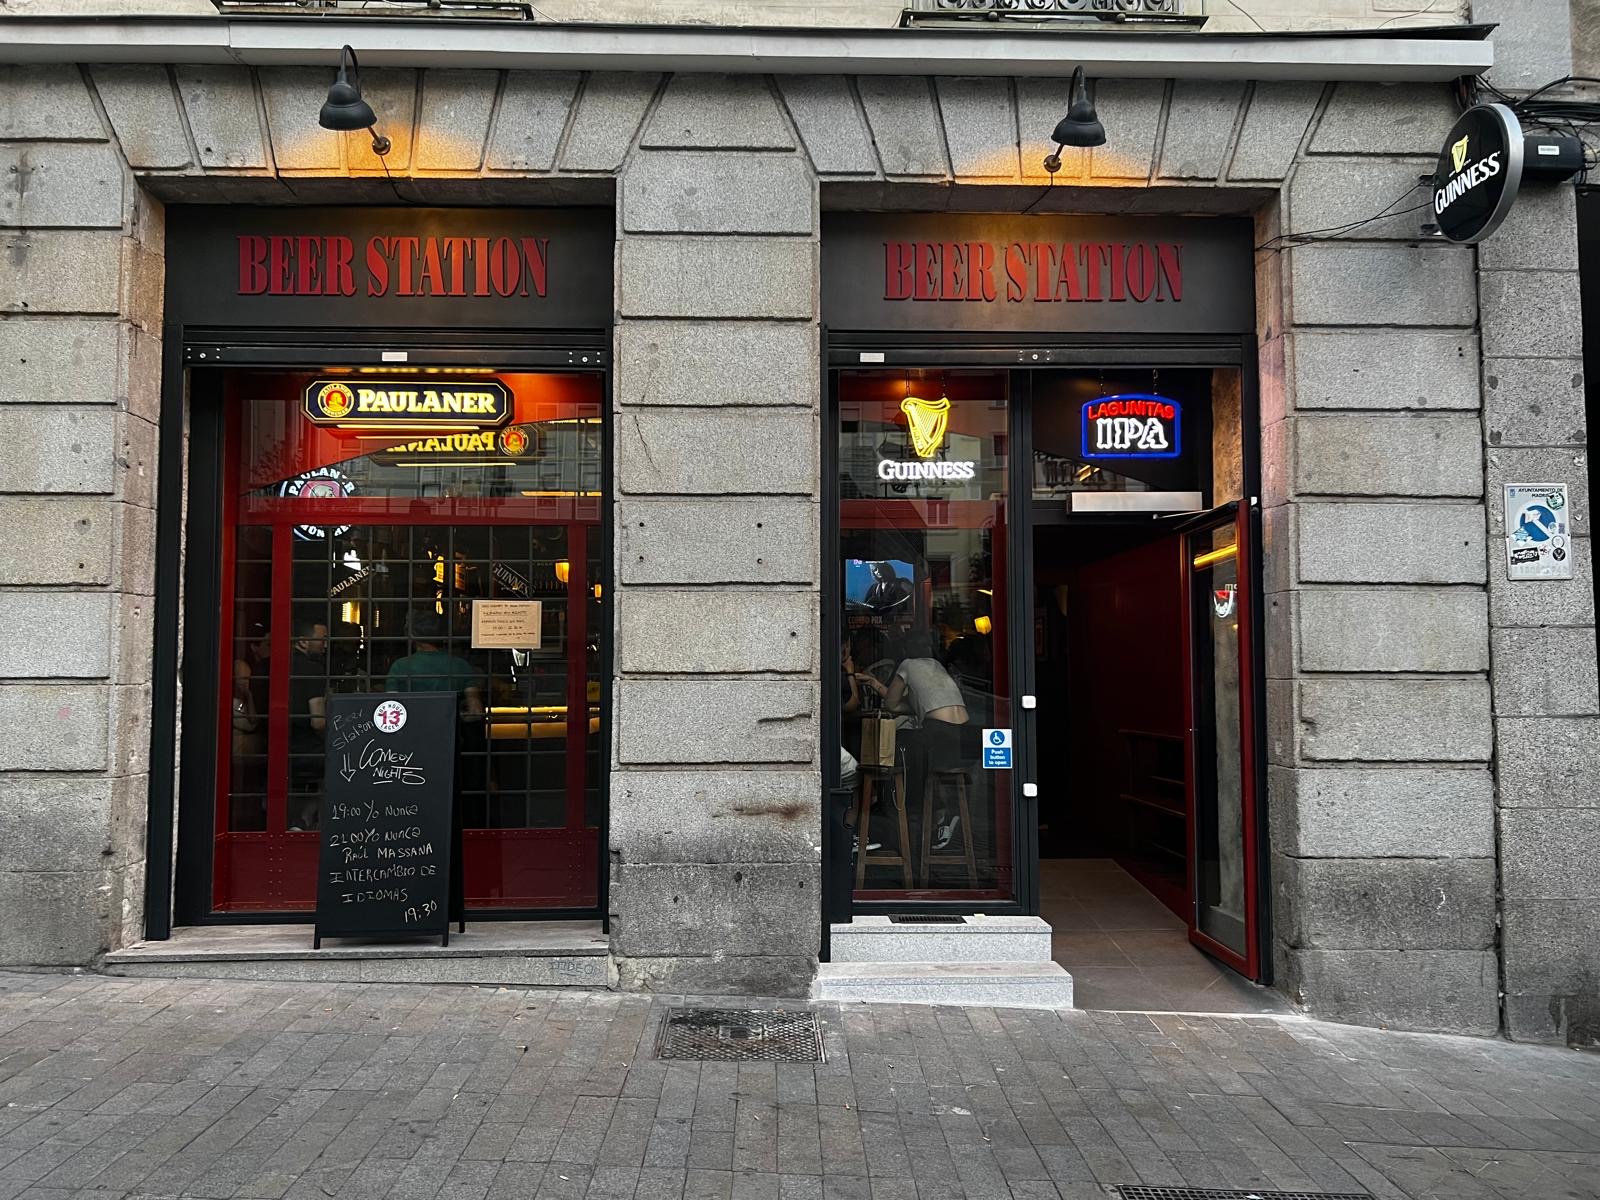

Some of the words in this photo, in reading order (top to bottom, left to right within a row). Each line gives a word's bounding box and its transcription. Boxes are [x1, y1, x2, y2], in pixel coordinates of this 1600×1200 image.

[1434, 150, 1501, 215] GUINNESS
[236, 235, 357, 297] BEER
[366, 236, 550, 298] STATION
[883, 240, 997, 303] BEER
[1004, 243, 1183, 303] STATION
[357, 389, 496, 414] PAULANER
[1088, 400, 1175, 420] LAGUNITAS
[1096, 417, 1169, 450] IPA
[878, 459, 976, 480] GUINNESS
[380, 710, 400, 725] 13
[377, 842, 433, 859] MASSANA
